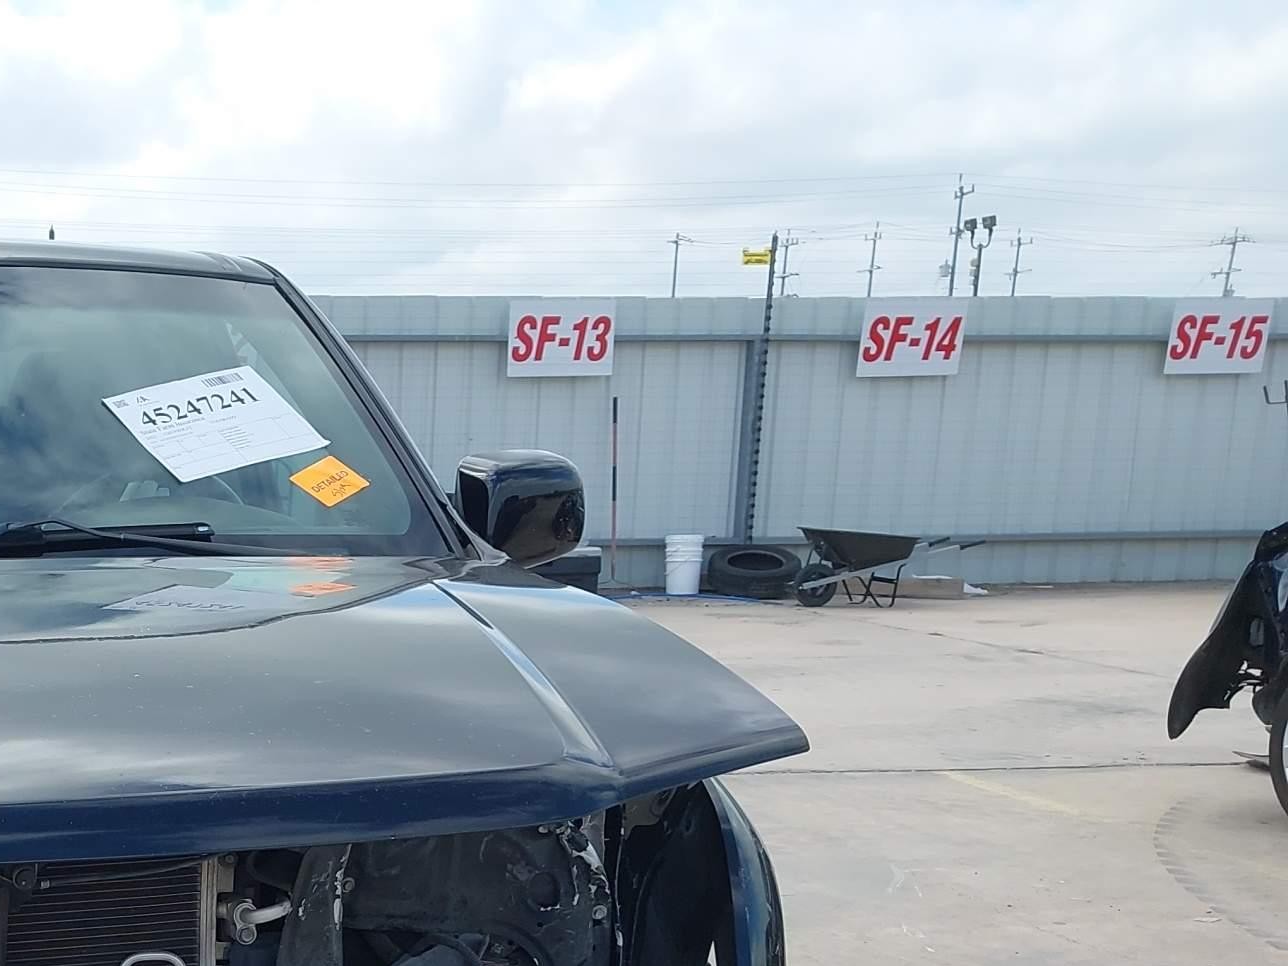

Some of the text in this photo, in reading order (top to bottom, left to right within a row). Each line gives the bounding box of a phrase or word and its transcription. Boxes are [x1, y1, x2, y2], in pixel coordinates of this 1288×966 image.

[511, 314, 612, 363] SF-13
[862, 315, 963, 363] SF-14
[1169, 314, 1269, 360] SF-15
[142, 387, 260, 426] 45247241
[311, 470, 349, 493] DETAILED
